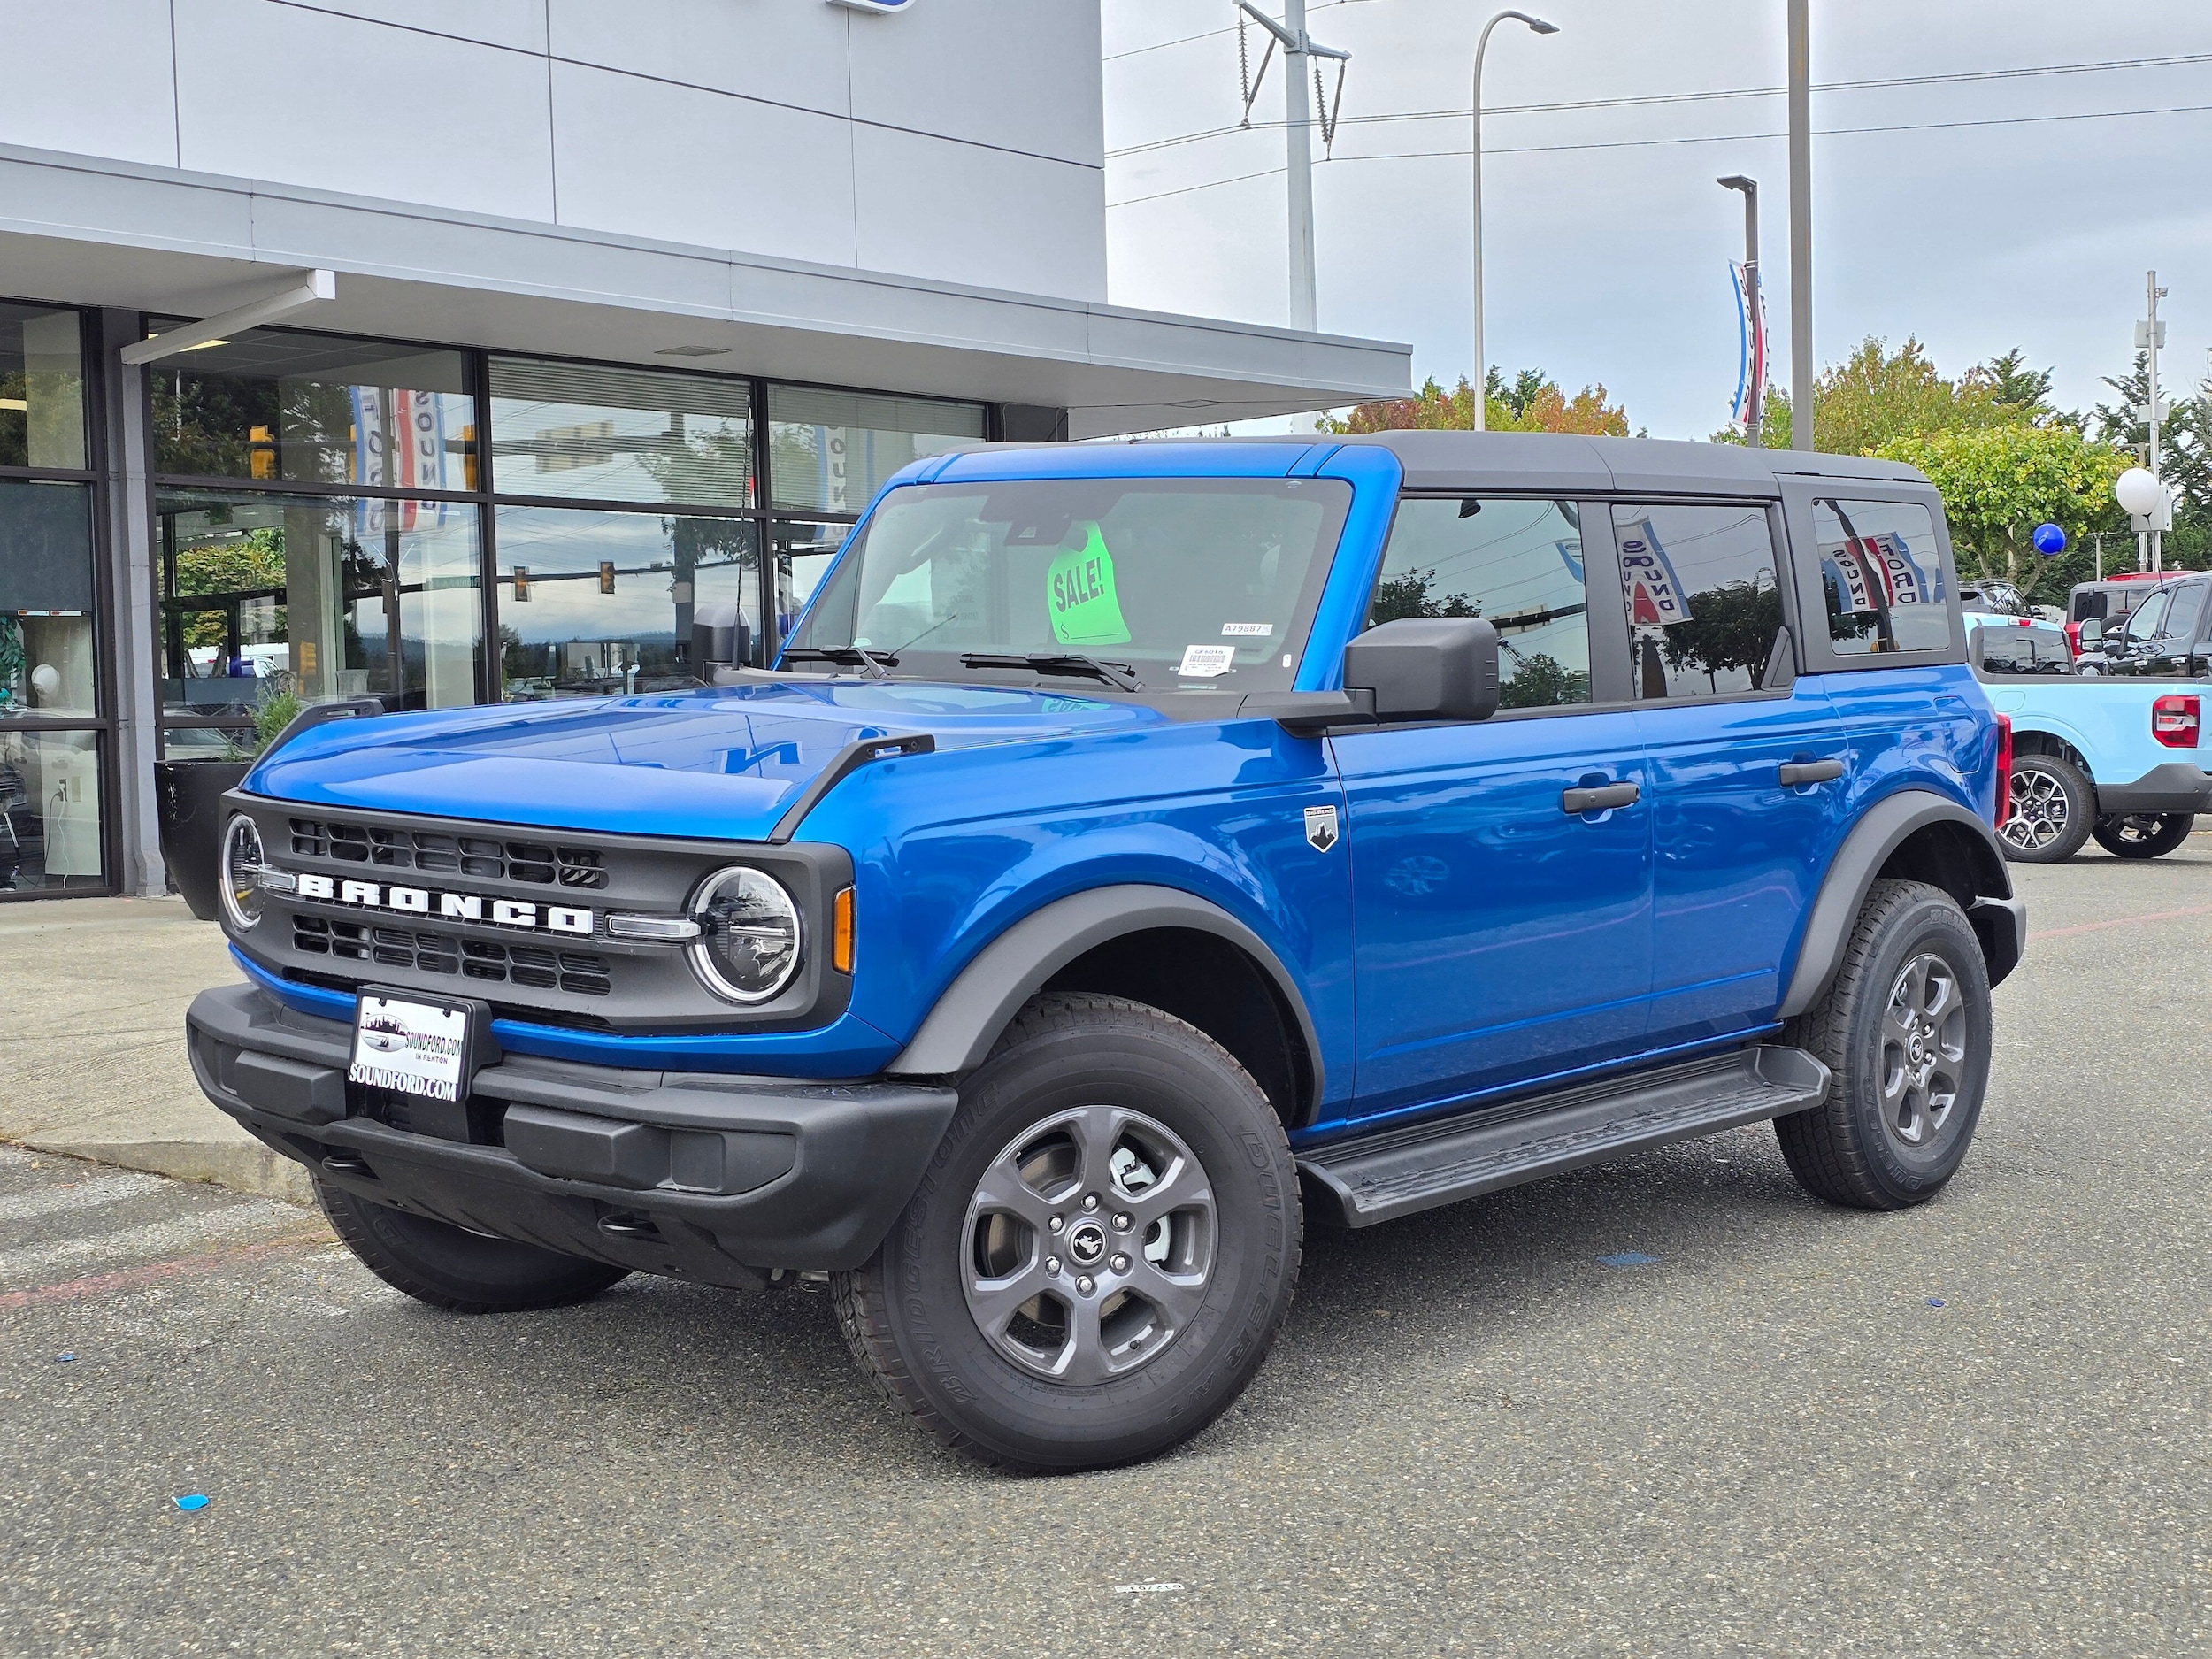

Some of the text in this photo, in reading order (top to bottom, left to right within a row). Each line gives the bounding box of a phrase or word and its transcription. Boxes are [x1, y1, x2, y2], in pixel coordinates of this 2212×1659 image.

[1054, 556, 1105, 612] SALE!
[1060, 621, 1070, 642] $
[1225, 625, 1263, 634] A79887
[298, 872, 594, 935] BRONCO
[405, 1031, 464, 1057] SOUNDFORD.COM
[423, 1054, 449, 1064] RENTON
[349, 1061, 458, 1102] SOUNDFORD.COM
[1224, 1126, 1285, 1369] DUELER
